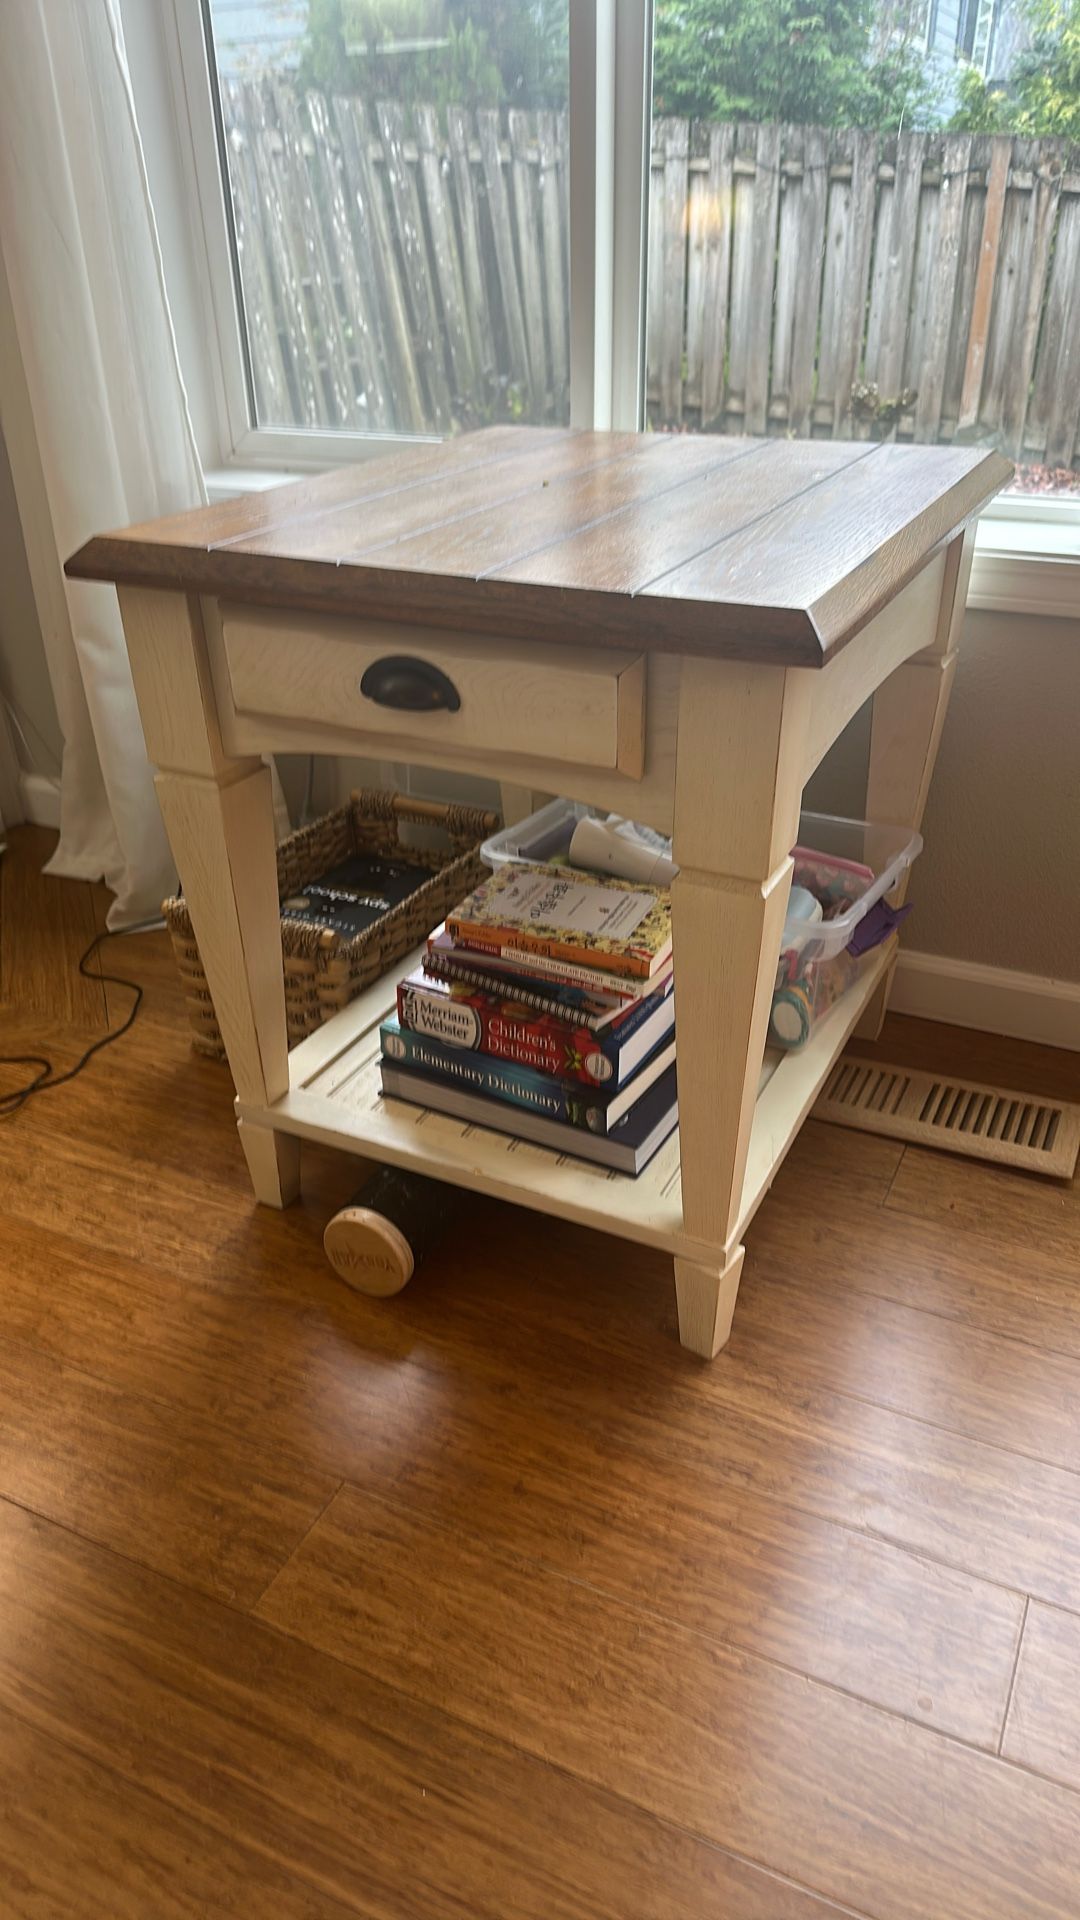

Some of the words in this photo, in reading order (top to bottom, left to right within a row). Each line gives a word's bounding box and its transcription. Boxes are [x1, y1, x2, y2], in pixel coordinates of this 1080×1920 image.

[421, 1014, 468, 1040] Webster
[488, 1018, 556, 1052] Children's
[488, 1034, 560, 1074] Dictionary
[412, 1045, 484, 1087] Elementary
[488, 1073, 560, 1113] Dictionary
